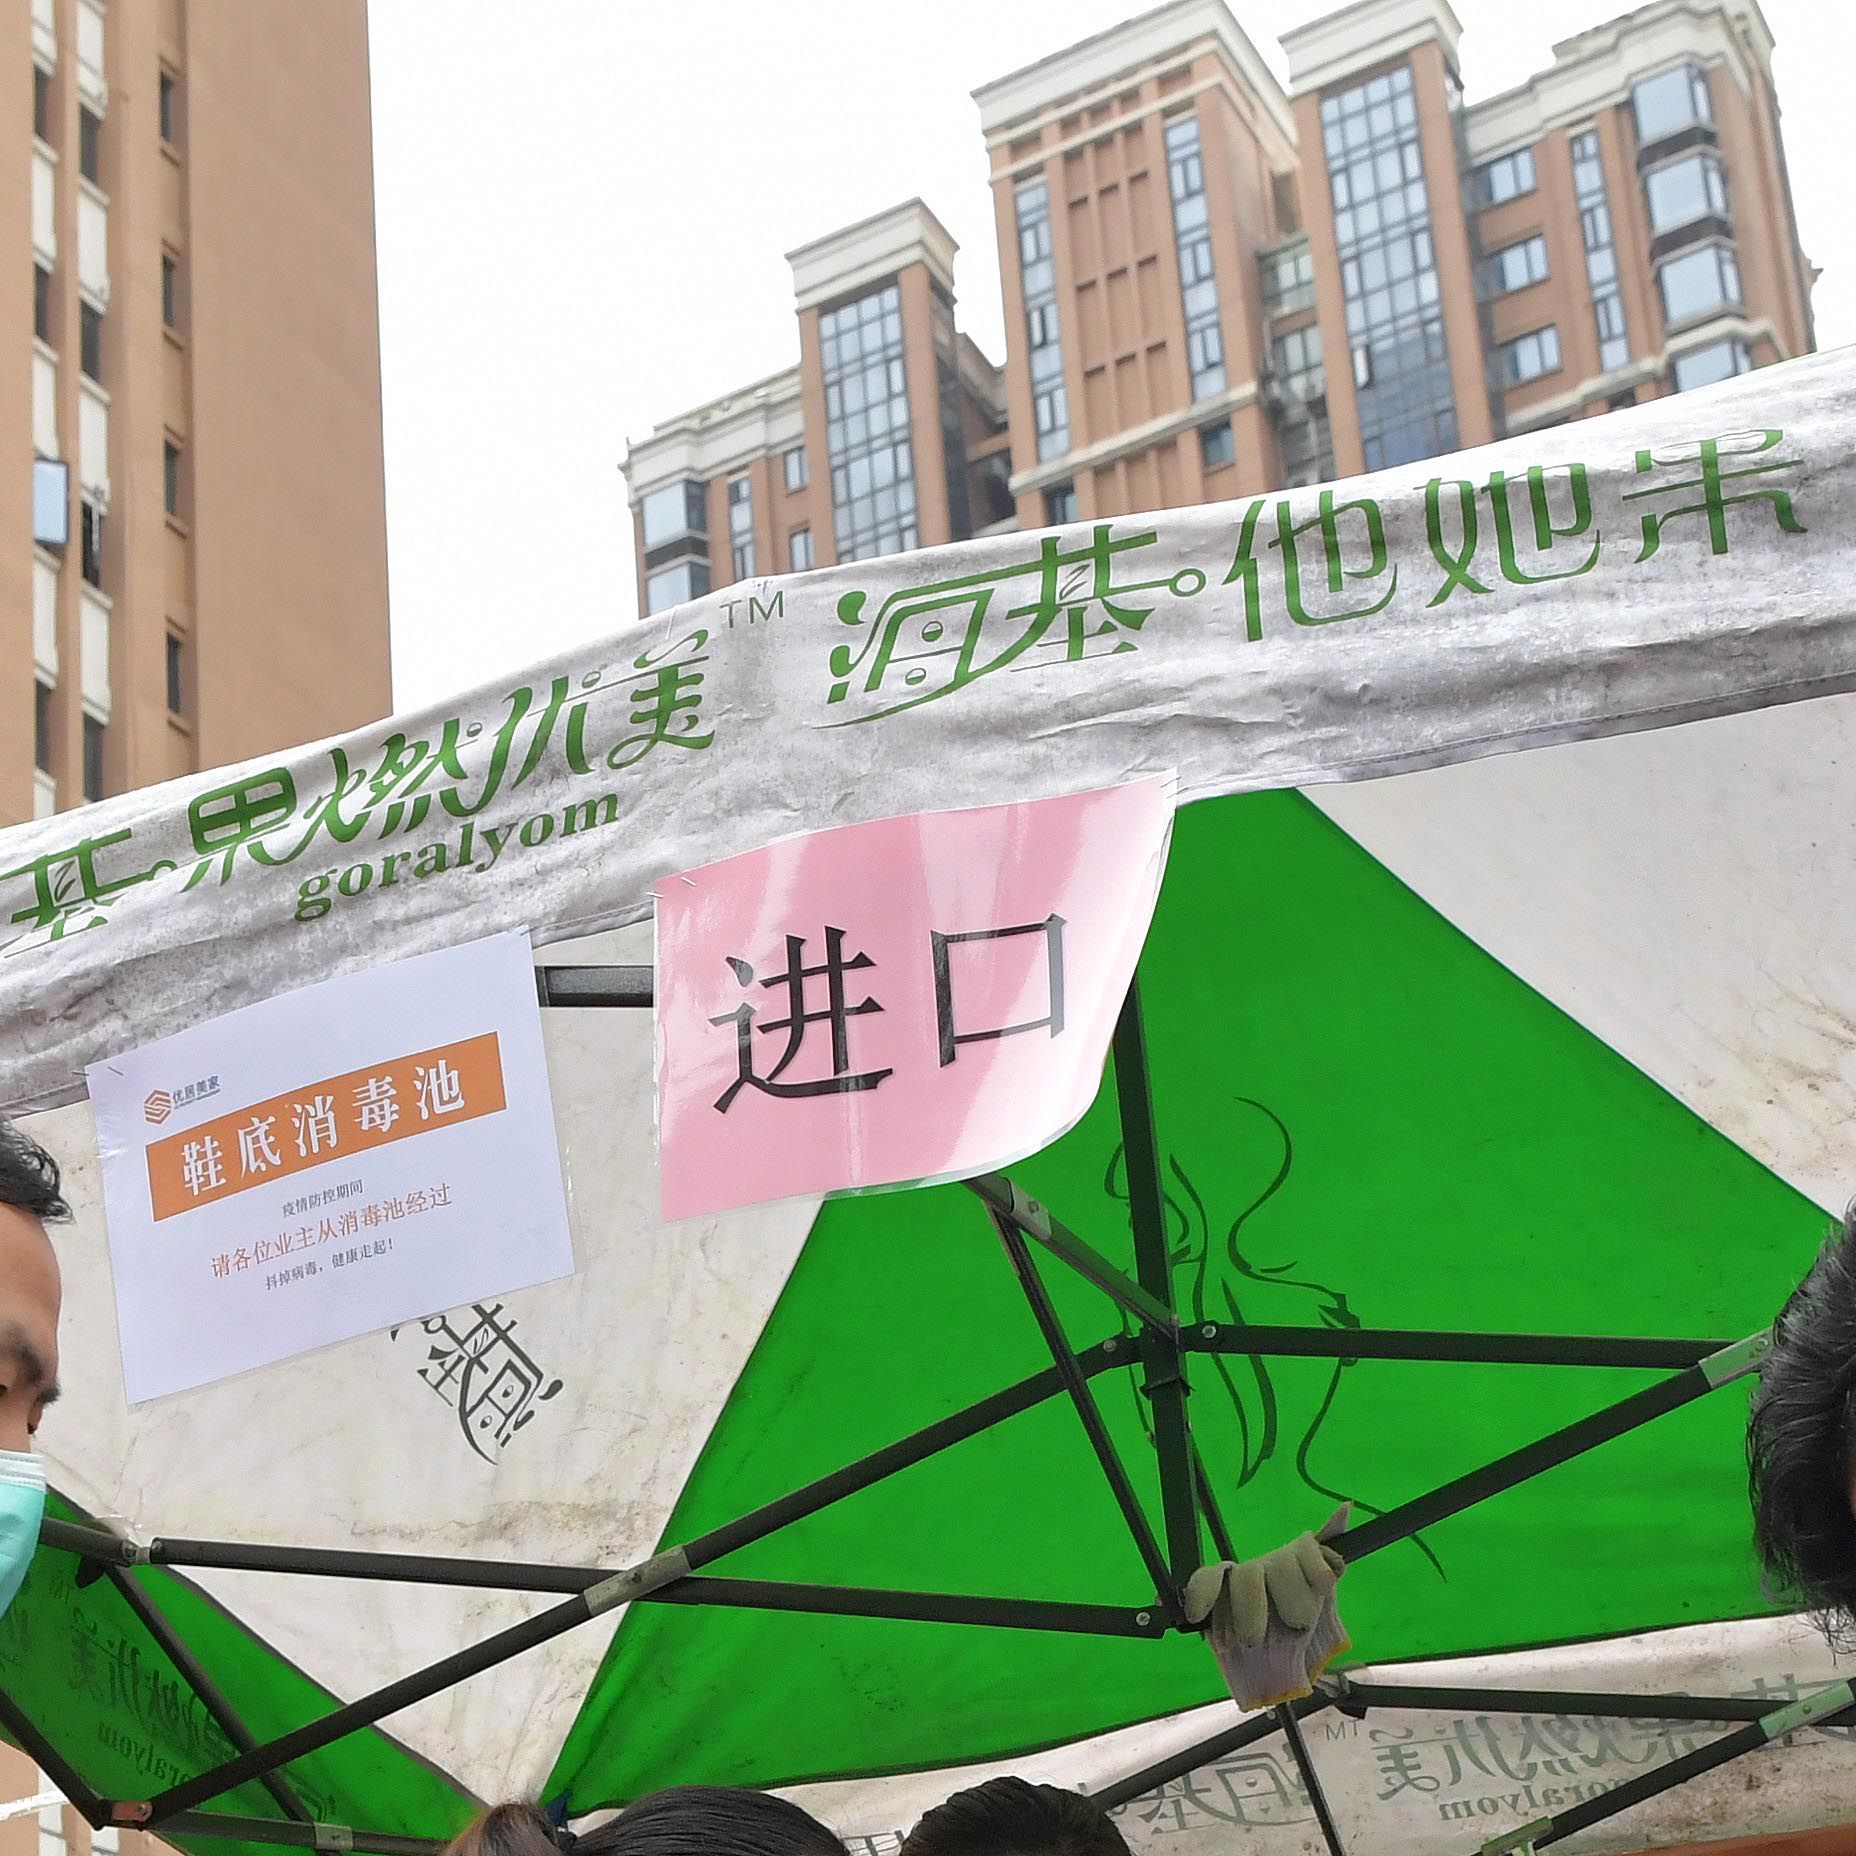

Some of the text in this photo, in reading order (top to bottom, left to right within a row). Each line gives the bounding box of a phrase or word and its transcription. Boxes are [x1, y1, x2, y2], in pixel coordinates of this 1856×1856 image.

[293, 793, 620, 923] goralyom
[708, 912, 1067, 1114] 进口
[181, 1058, 465, 1197] 鞋底消毒池
[211, 1182, 452, 1279] 请各位业主从消毒池经过
[281, 1179, 364, 1218] 疫情防控期间
